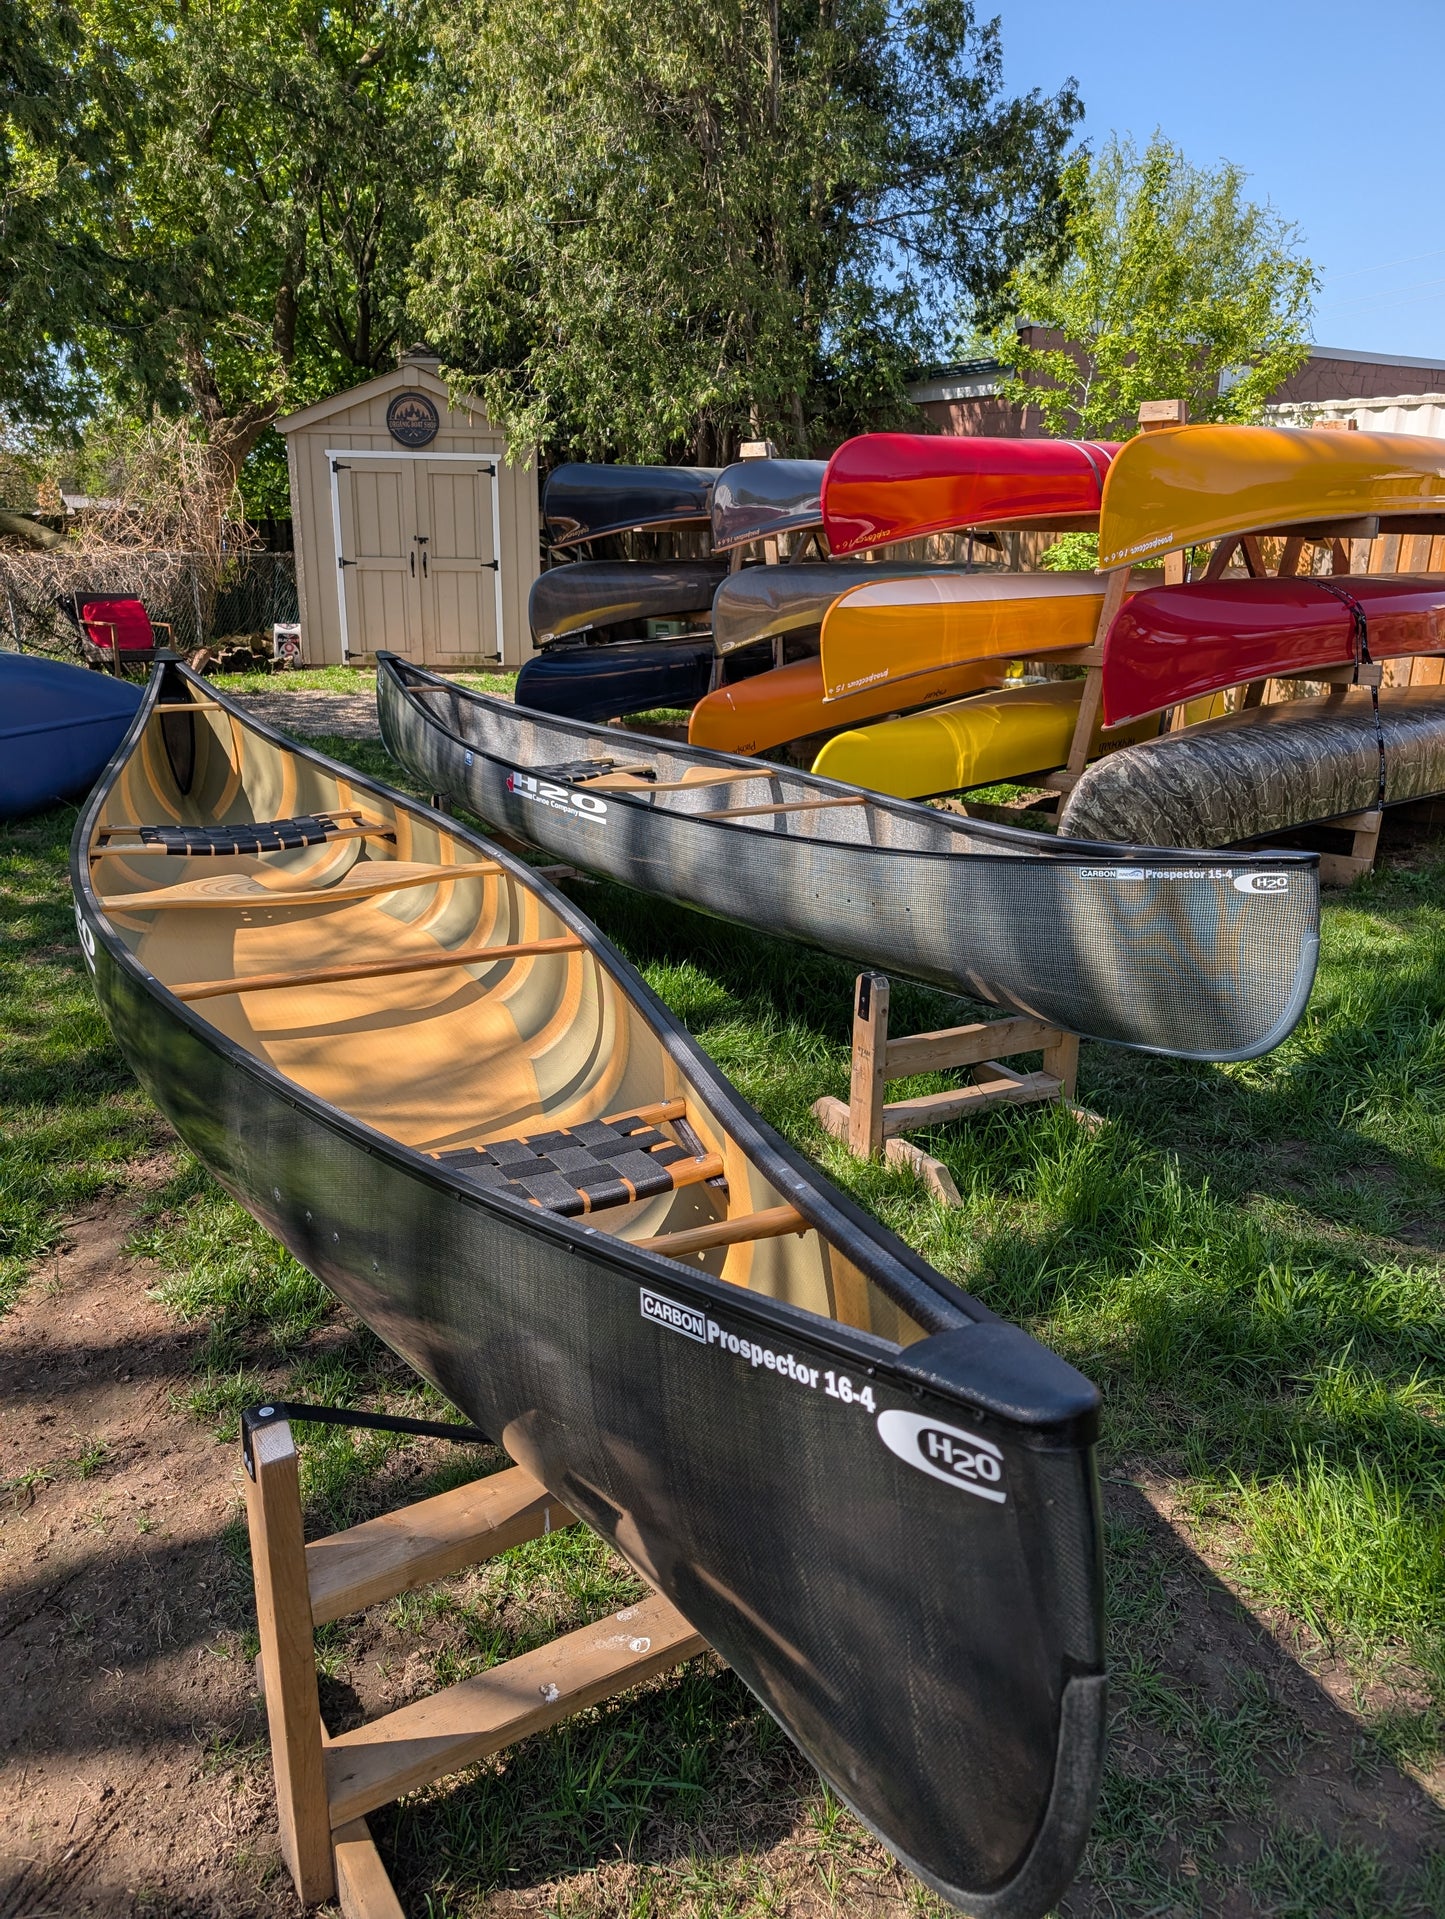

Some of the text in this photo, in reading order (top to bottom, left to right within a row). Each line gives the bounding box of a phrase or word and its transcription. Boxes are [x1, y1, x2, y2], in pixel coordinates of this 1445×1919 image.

[1111, 549, 1128, 561] 16.6
[532, 793, 579, 816] Canoe Company
[1081, 870, 1116, 878] CARBON
[1145, 869, 1205, 880] Prospector
[1208, 869, 1233, 879] 15-4
[643, 1296, 703, 1336] CARBON
[707, 1319, 876, 1413] Prospector 16-4
